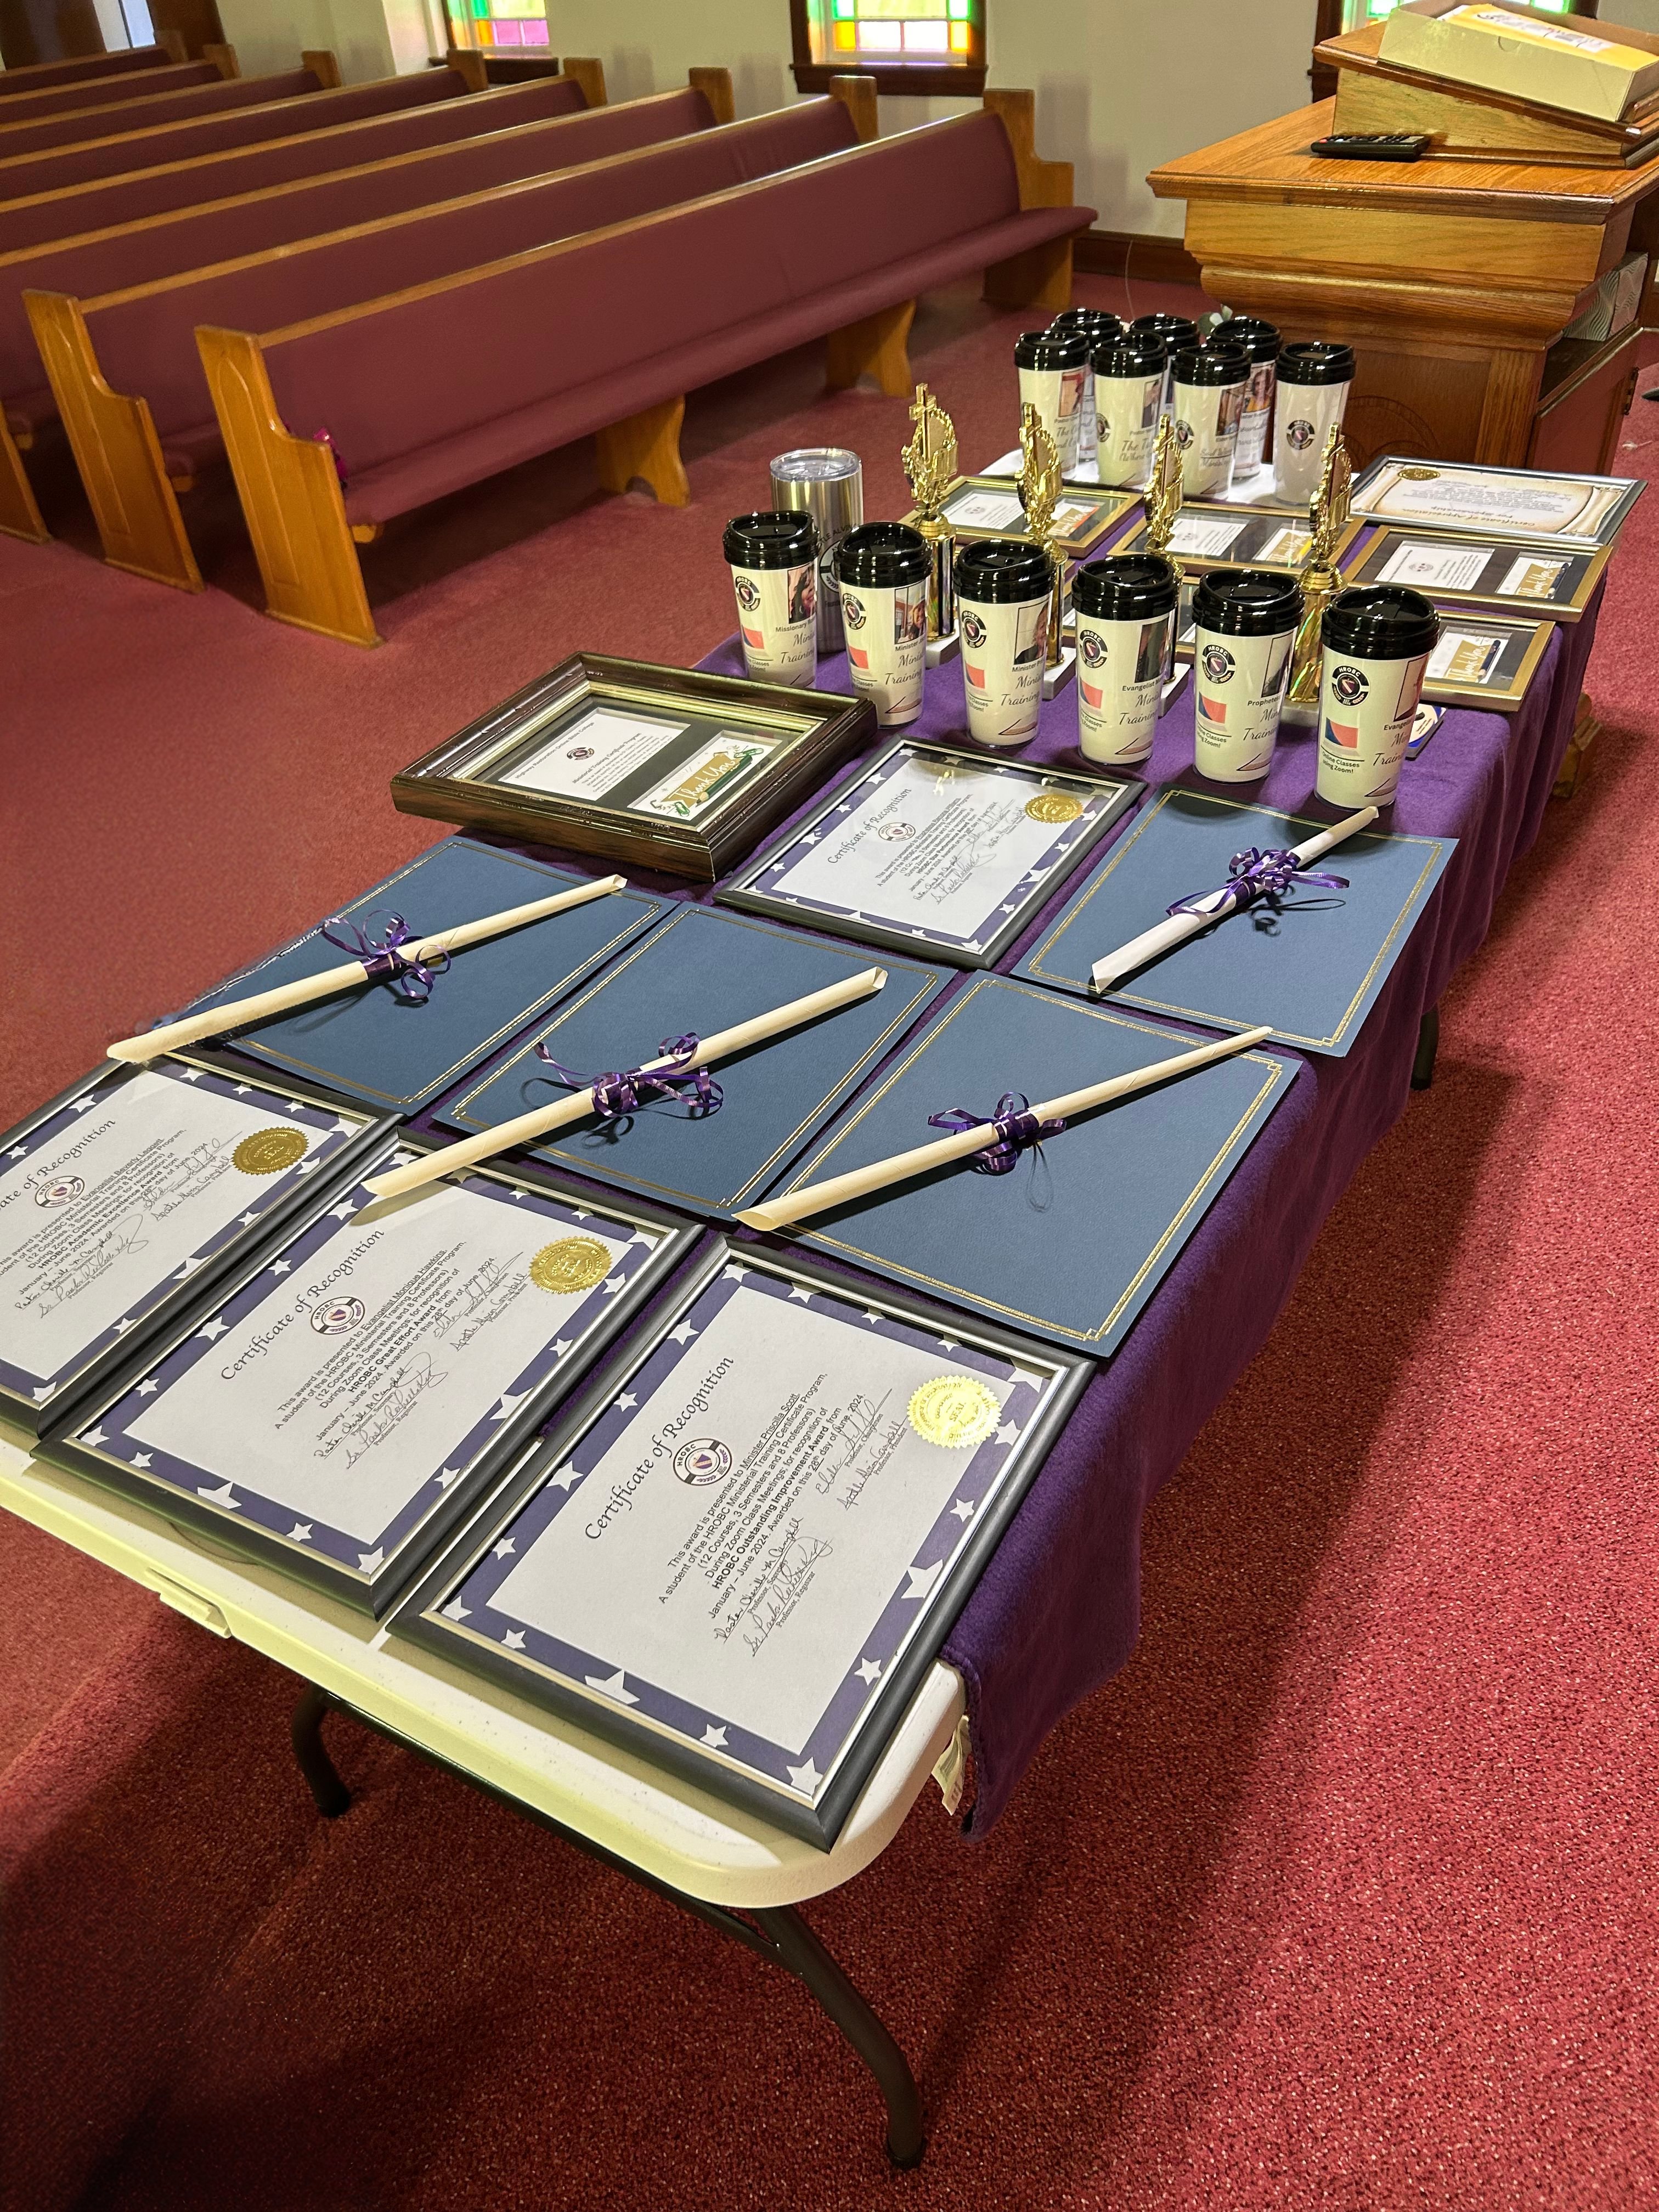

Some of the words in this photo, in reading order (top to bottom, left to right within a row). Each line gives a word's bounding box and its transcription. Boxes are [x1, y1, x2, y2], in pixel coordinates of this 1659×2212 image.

[775, 623, 806, 632] Missionary
[1084, 630, 1102, 643] HROBC
[895, 641, 918, 652] Minister
[1207, 646, 1229, 657] HROBC
[1012, 664, 1036, 673] Minister
[1338, 666, 1361, 678] HROBC
[1122, 681, 1155, 692] Evangelist
[1204, 738, 1221, 748] Zoom!
[1206, 732, 1227, 743] Classes
[1334, 765, 1354, 774] Zoom!
[1336, 759, 1360, 768] Classes
[668, 776, 713, 800] Thank
[703, 759, 736, 781] You
[869, 788, 912, 823] Recognition
[862, 821, 878, 831] of
[827, 831, 867, 864] Certificate
[23, 1175, 39, 1190] of
[36, 1120, 115, 1176] Recognition
[37, 1246, 68, 1269] HROBC
[67, 1218, 104, 1246] Academic
[101, 1189, 140, 1218] Excellence
[139, 1170, 163, 1189] Award
[162, 1157, 179, 1170] from
[0, 1256, 12, 1265] his
[221, 1314, 294, 1379] Certificate
[294, 1295, 313, 1313] of
[307, 1231, 384, 1297] Recognition
[315, 1301, 336, 1319] HROBC
[276, 1397, 296, 1411] This
[294, 1375, 318, 1397] award
[322, 1336, 356, 1370] presented
[360, 1299, 396, 1330] Evangelist
[392, 1274, 422, 1300] Monique
[347, 1365, 377, 1393] HROBC
[375, 1345, 397, 1365] Great
[393, 1326, 416, 1346] Effort
[413, 1304, 437, 1327] Award
[435, 1289, 452, 1304] from
[799, 1373, 828, 1403] Program,
[775, 1403, 804, 1438] Certificate
[585, 1459, 653, 1539] Certificate
[651, 1436, 673, 1459] of
[662, 1358, 733, 1438] Recognition
[676, 1443, 697, 1466] HROBC
[753, 1438, 781, 1467] Training
[872, 1451, 893, 1475] Professor,
[667, 1550, 686, 1567] This
[682, 1523, 704, 1550] award
[698, 1516, 710, 1525] is
[707, 1477, 737, 1516] presented
[732, 1469, 744, 1477] to
[739, 1439, 767, 1470] Minister
[760, 1412, 787, 1441] Priscilla
[697, 1553, 713, 1568] (12
[708, 1520, 736, 1553] Courses,
[737, 1470, 771, 1510] Semesters
[768, 1454, 782, 1470] and
[781, 1408, 816, 1448] Professors)
[704, 1550, 730, 1578] During
[724, 1526, 746, 1551] Zoom
[741, 1503, 761, 1526] Class
[757, 1466, 788, 1503] Meetings;
[782, 1454, 795, 1466] for
[792, 1416, 822, 1455] recognition
[819, 1406, 828, 1416] of
[711, 1555, 740, 1589] HROBC
[736, 1503, 777, 1554] Outstanding
[771, 1451, 812, 1503] Improvement
[807, 1425, 829, 1451] Award
[825, 1407, 842, 1425] from
[726, 1468, 758, 1506] Ministerial
[702, 1506, 730, 1539] HROBC
[708, 1583, 736, 1619] January
[736, 1555, 755, 1576] June
[750, 1533, 769, 1555] 2024.
[767, 1496, 794, 1531] Awarded
[792, 1485, 803, 1497] on
[798, 1471, 812, 1485] this
[829, 1431, 838, 1441] of
[687, 1551, 698, 1564] of
[692, 1540, 708, 1554] the
[665, 1563, 691, 1595] student
[746, 1585, 771, 1616] Professor,
[775, 1598, 800, 1628] Professor,
